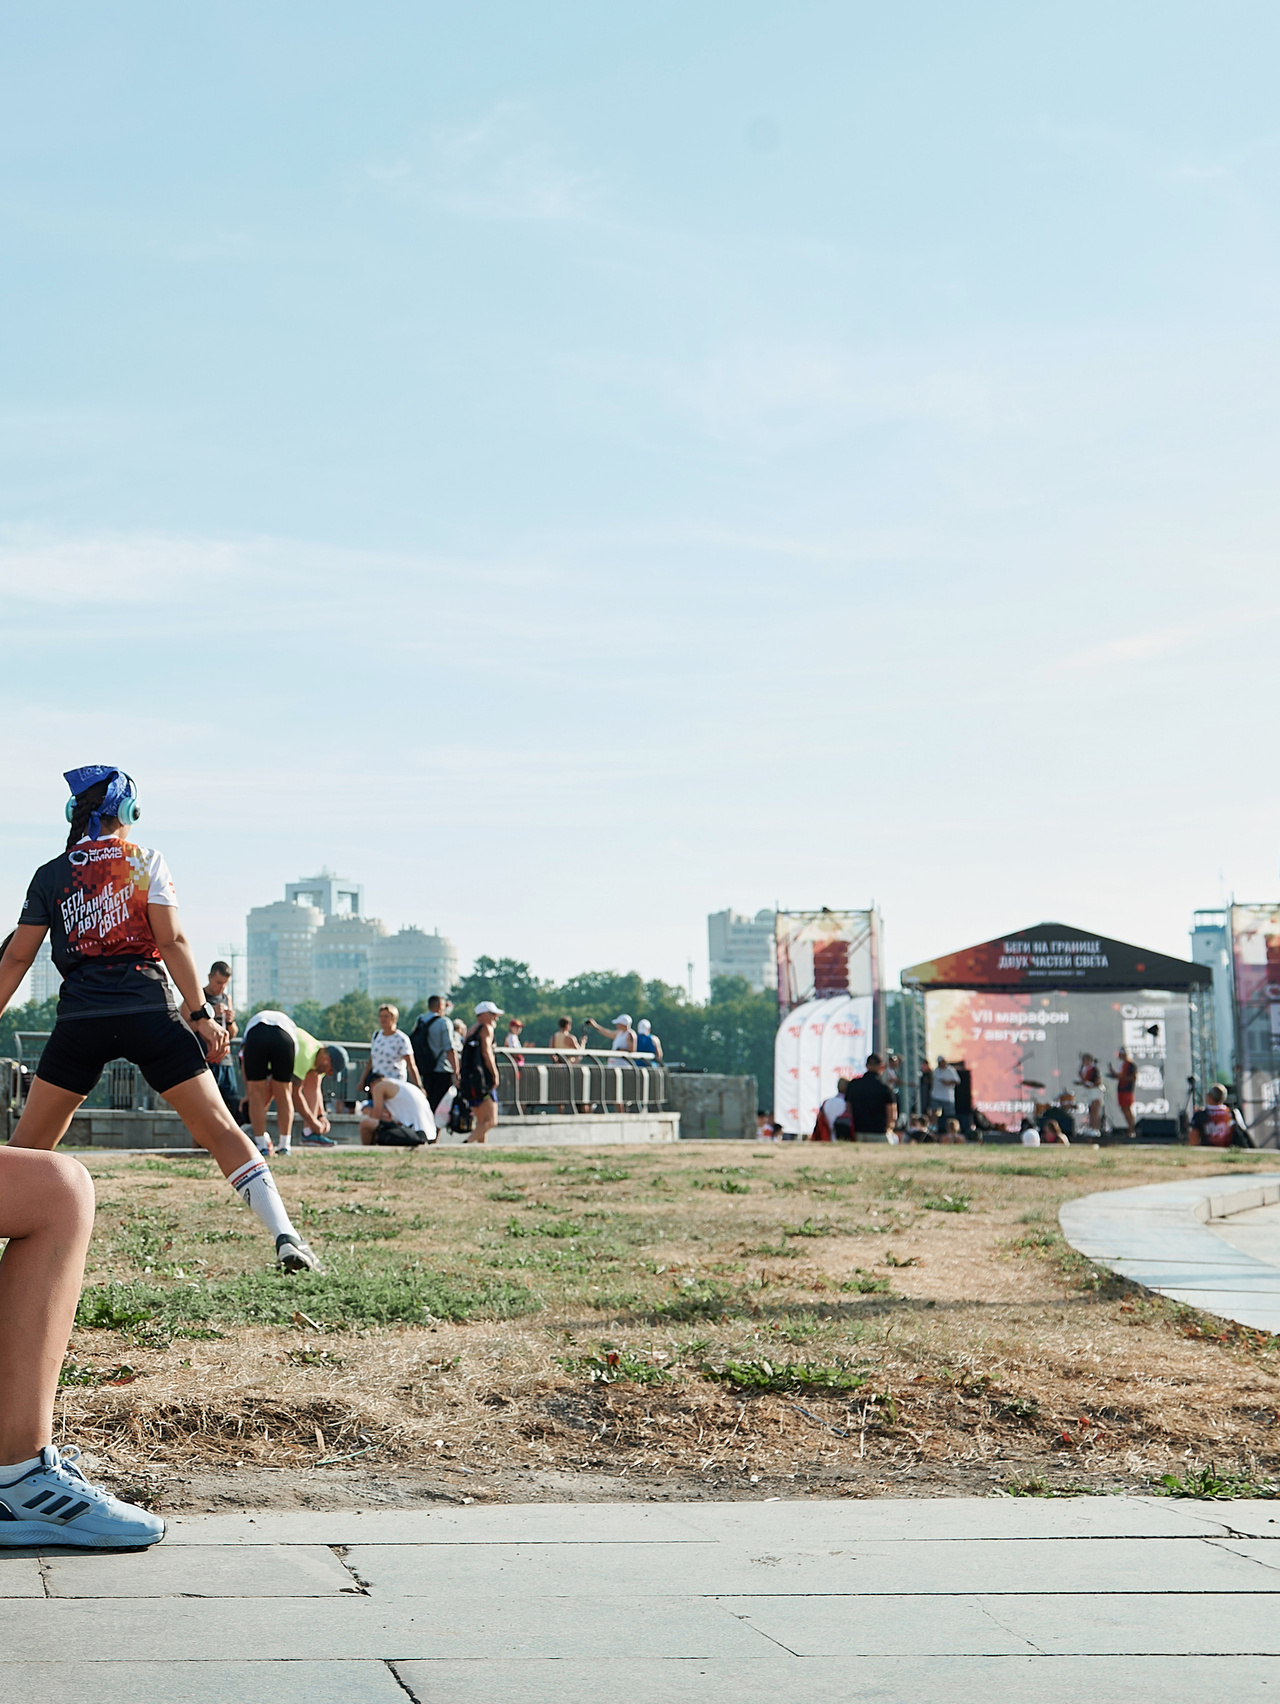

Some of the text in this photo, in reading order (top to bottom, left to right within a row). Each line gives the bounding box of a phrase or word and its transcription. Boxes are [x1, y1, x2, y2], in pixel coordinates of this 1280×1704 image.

[61, 888, 84, 920] БЕГИ
[78, 907, 102, 938] ДВУХ
[99, 902, 130, 938] СВЕТА
[1004, 940, 1101, 954] БЕГИ НА ГРАНИЦЕ
[1030, 954, 1072, 968] ЧАСТЕЙ
[1074, 955, 1109, 968] СВЕТА
[971, 1009, 1069, 1026] VII марафон
[972, 1027, 1046, 1044] 7 августа
